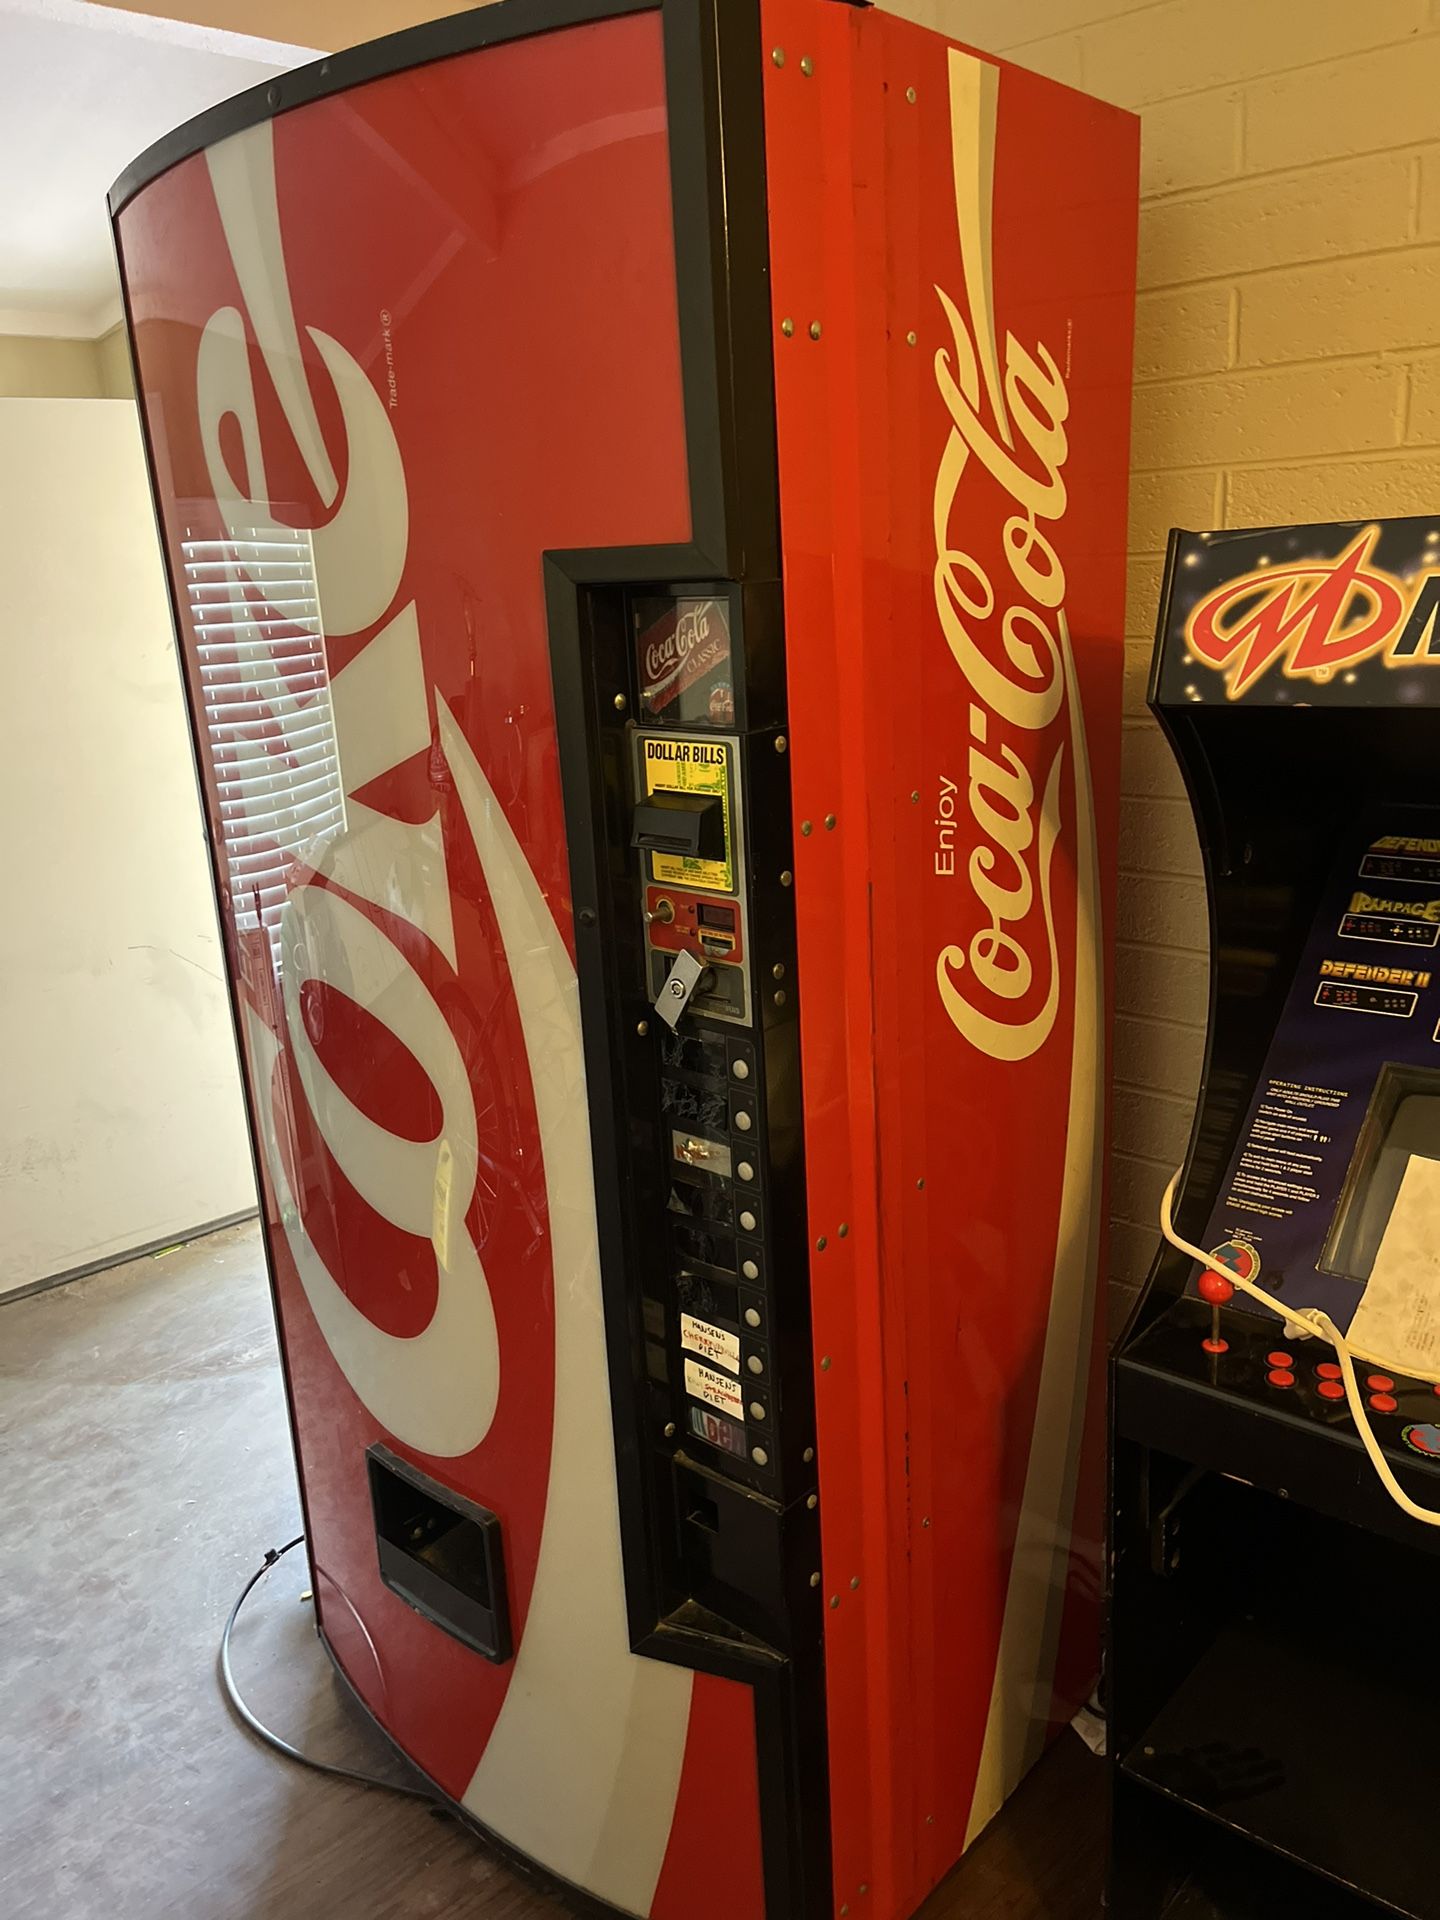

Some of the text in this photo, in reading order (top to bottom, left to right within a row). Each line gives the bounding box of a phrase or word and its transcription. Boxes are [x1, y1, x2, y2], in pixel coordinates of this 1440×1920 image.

[647, 742, 724, 765] DOLLAR BILLS
[935, 775, 957, 876] Enjoy
[197, 305, 501, 1458] Coke
[1320, 960, 1414, 986] DEFENDER
[698, 1343, 722, 1360] DIET
[698, 1367, 737, 1393] HANSENS
[703, 1391, 727, 1405] DIET
